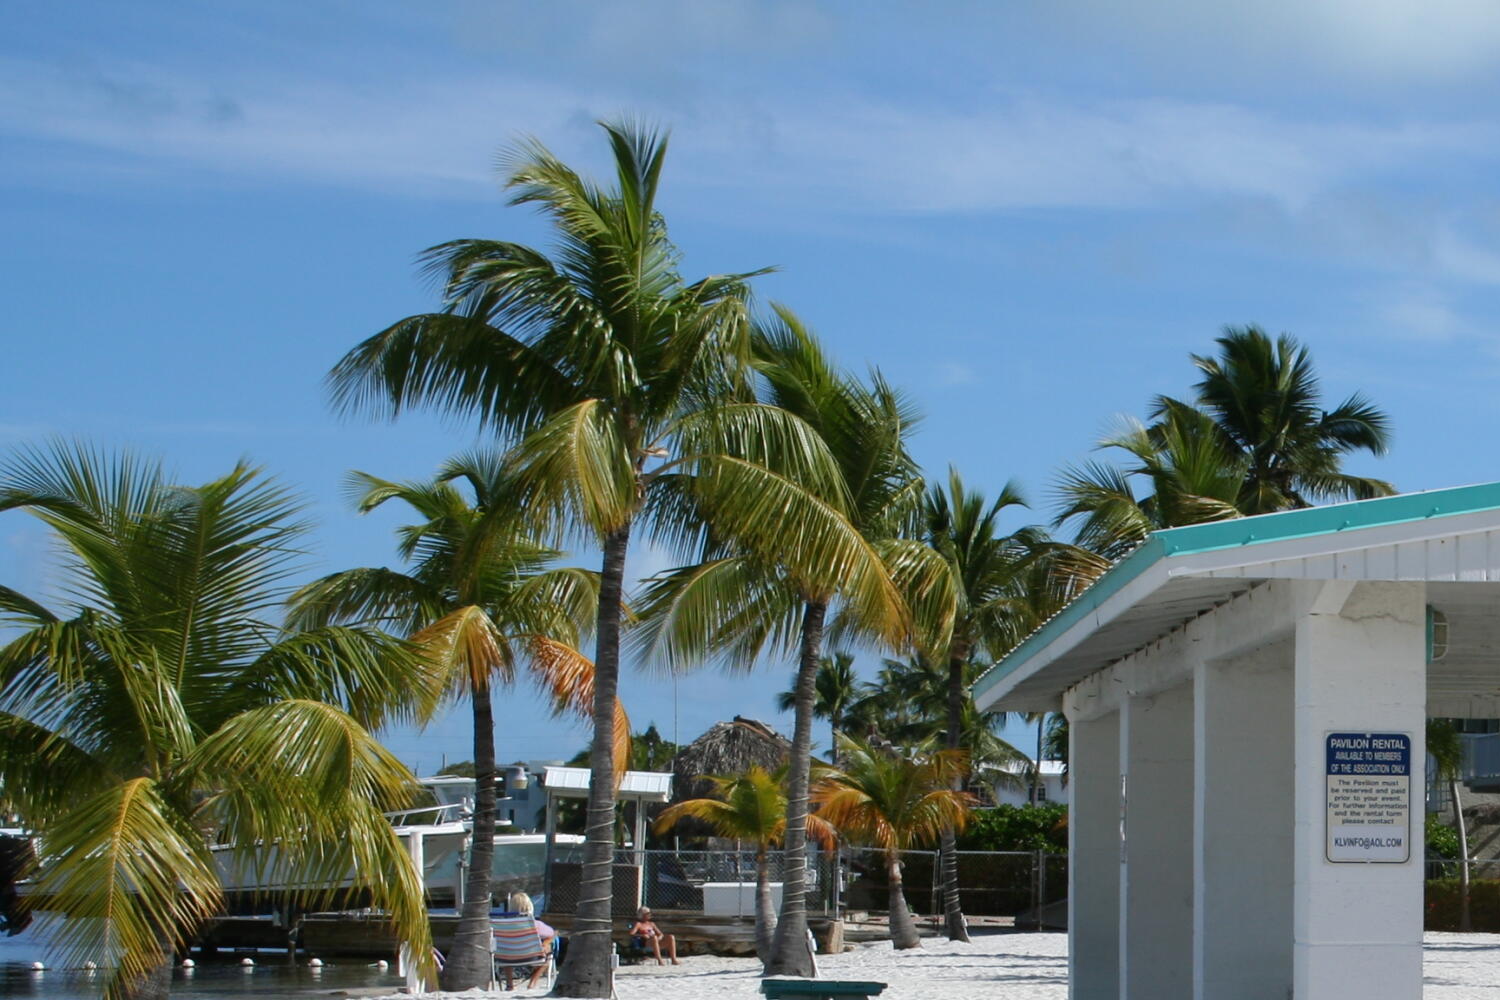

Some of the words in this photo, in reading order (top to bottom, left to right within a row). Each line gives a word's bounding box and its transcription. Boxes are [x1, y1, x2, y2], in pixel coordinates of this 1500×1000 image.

[1331, 739, 1369, 749] PAVILION
[1372, 739, 1406, 749] RENTAL
[1336, 752, 1364, 760] AVAILABLE
[1365, 752, 1373, 760] TO
[1374, 752, 1402, 761] MEMBERS
[1331, 764, 1339, 773] OF
[1341, 764, 1352, 773] THE
[1353, 764, 1389, 773] ASSOCIATION
[1391, 765, 1405, 773] ONLY
[1334, 837, 1402, 850] KLVINFO@AOL.COM
